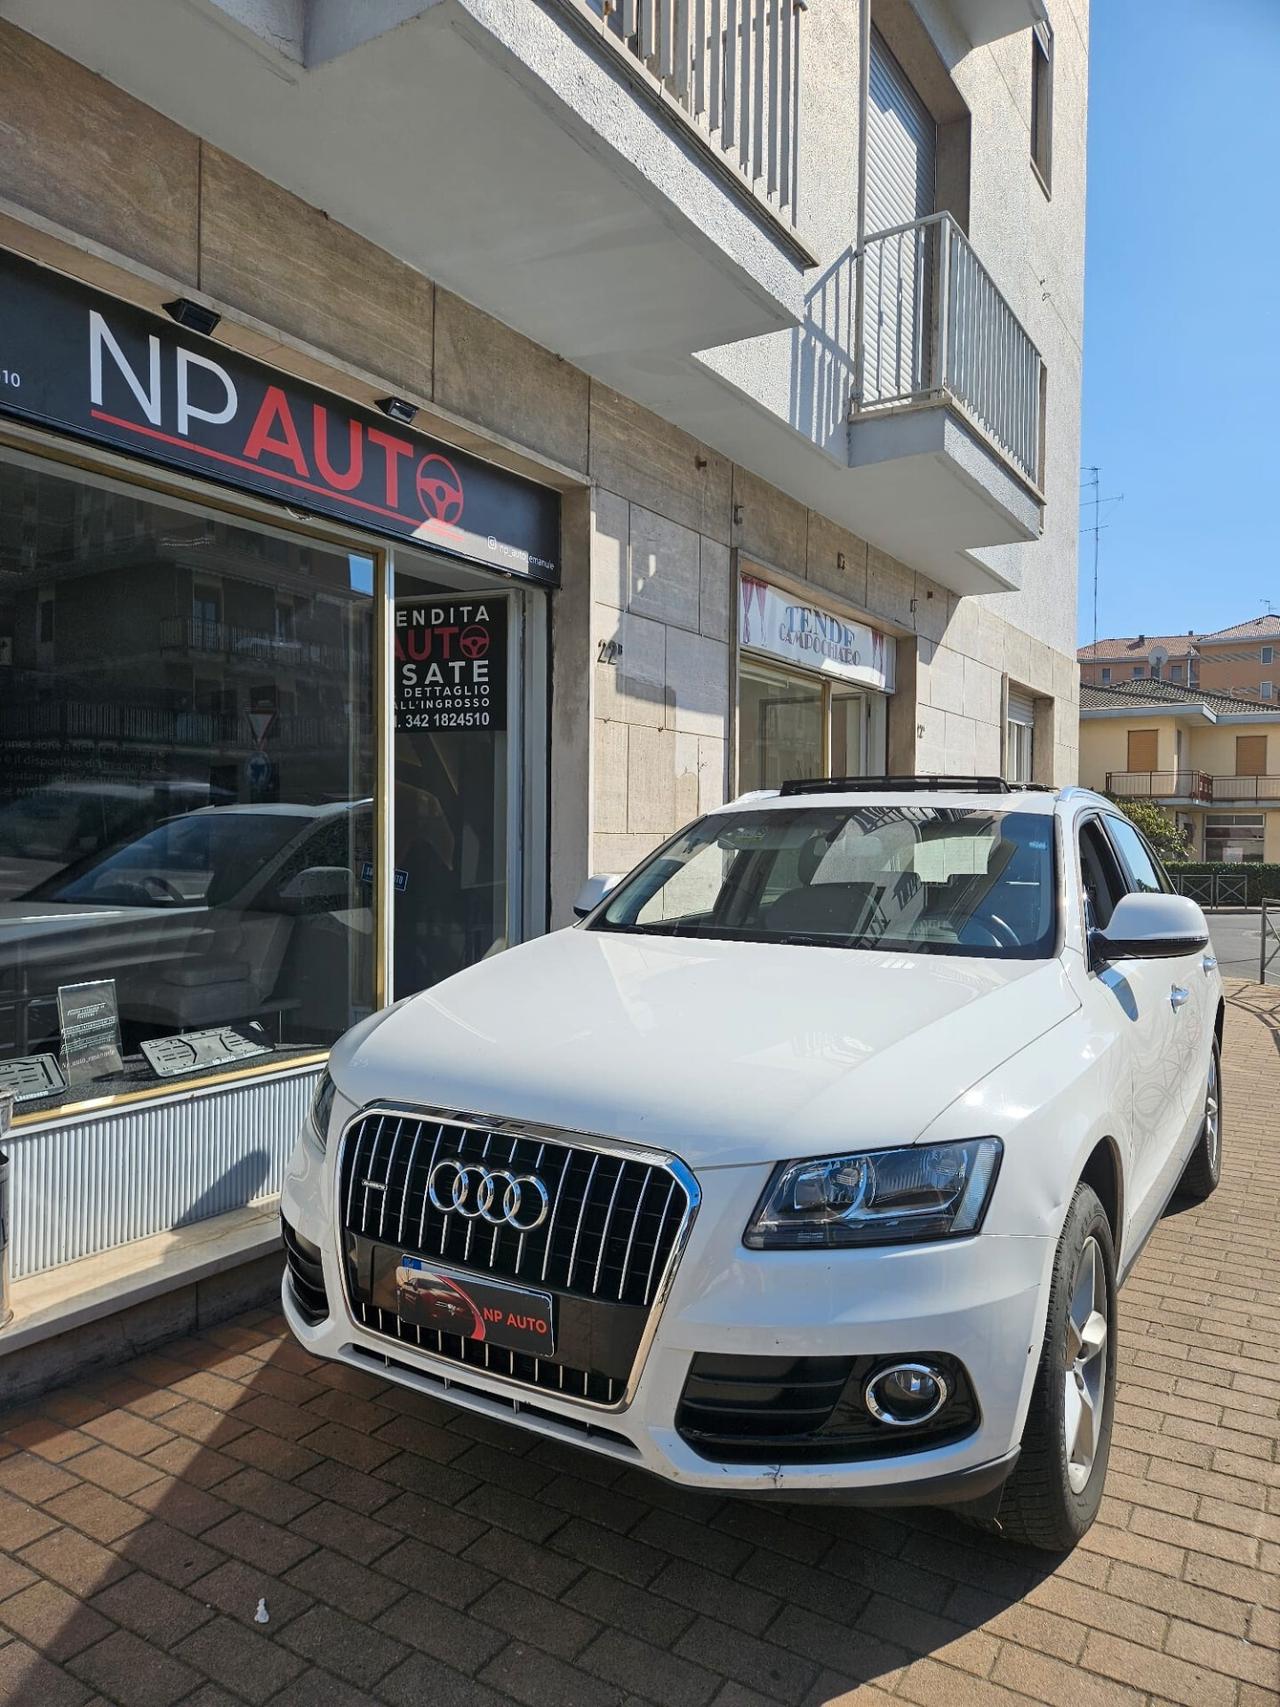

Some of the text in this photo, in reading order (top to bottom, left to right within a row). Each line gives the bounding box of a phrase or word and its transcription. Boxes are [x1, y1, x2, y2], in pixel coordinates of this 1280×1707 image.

[404, 684, 490, 698] DETTAGLIO
[405, 713, 429, 728] 342
[433, 711, 490, 727] 1824510
[483, 1307, 547, 1334] NP AUTO
